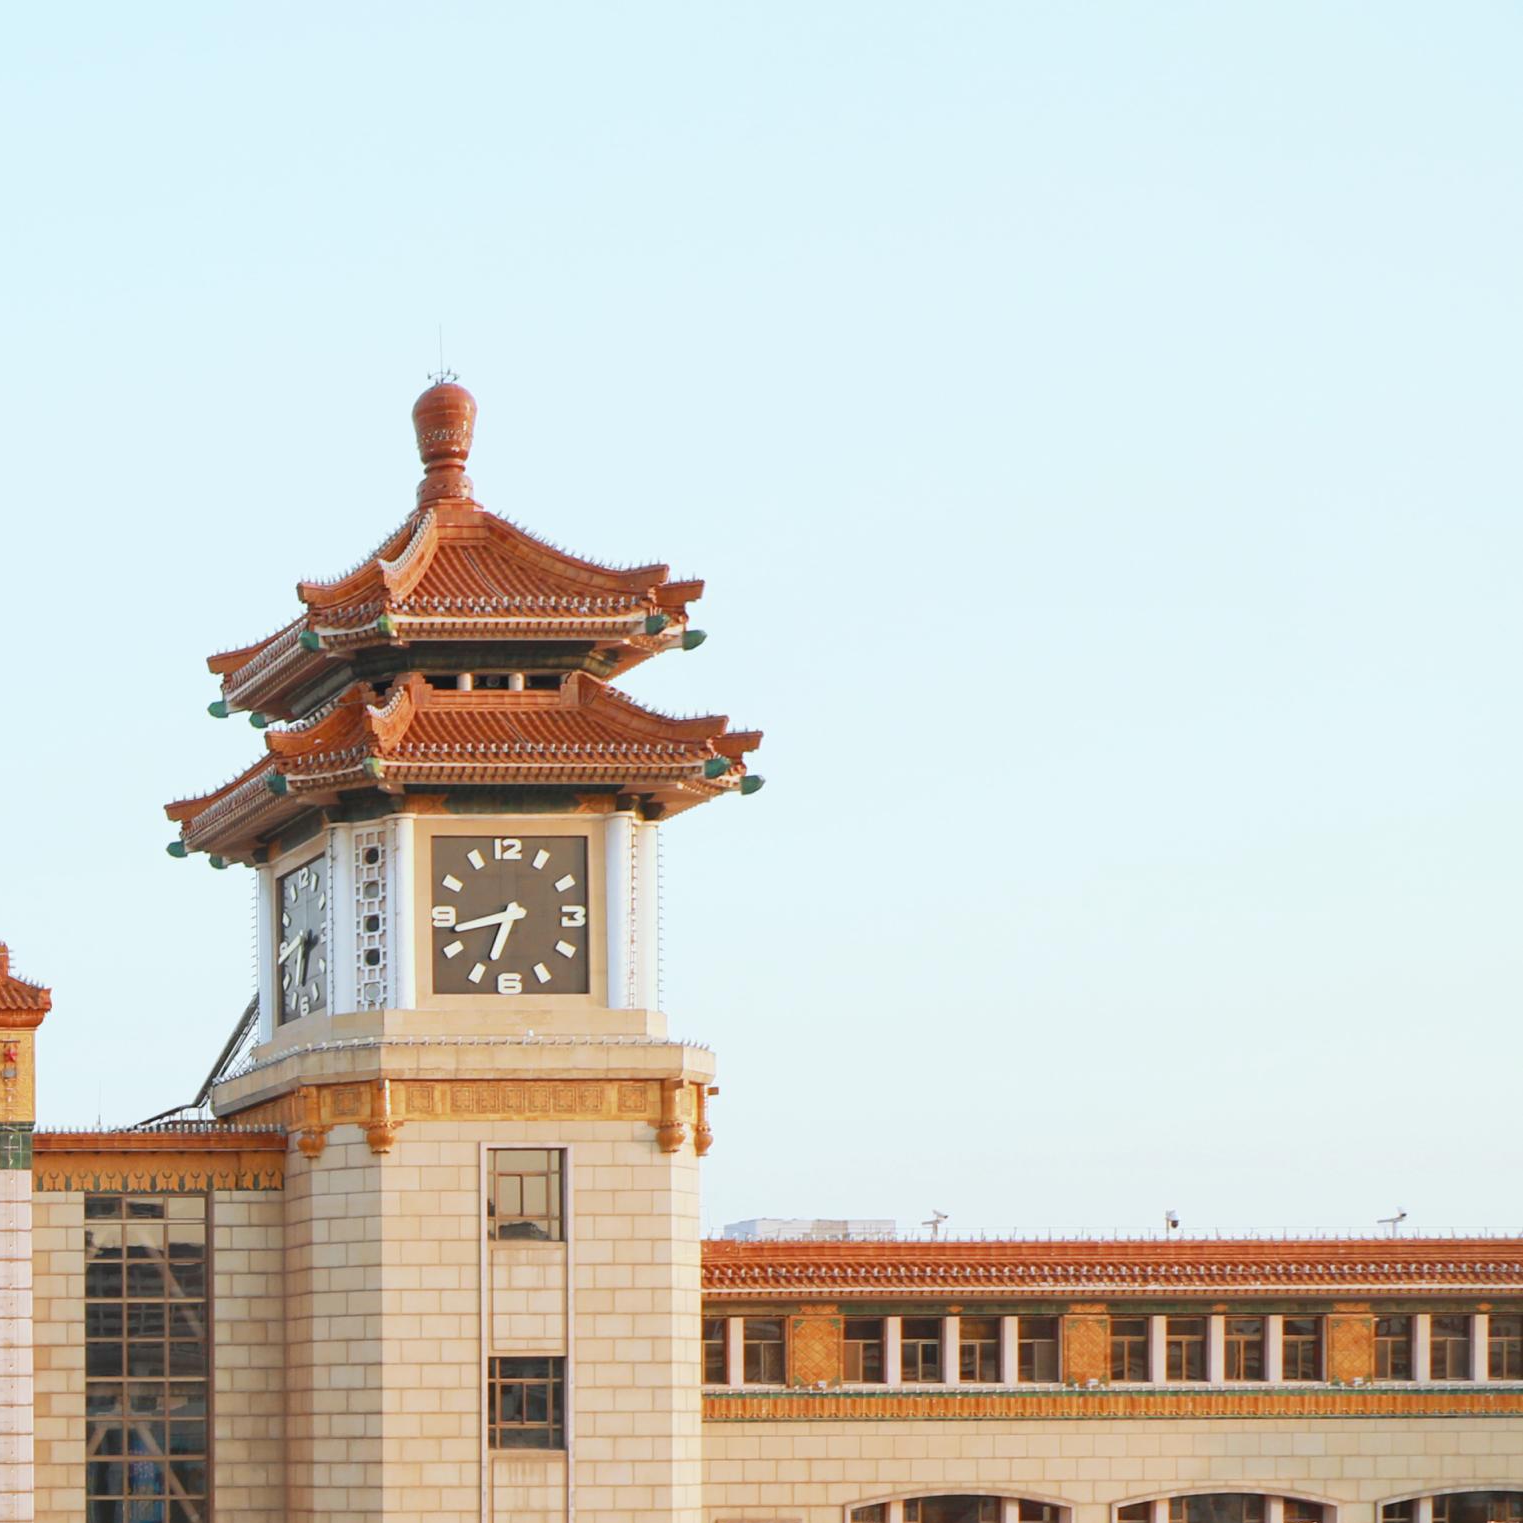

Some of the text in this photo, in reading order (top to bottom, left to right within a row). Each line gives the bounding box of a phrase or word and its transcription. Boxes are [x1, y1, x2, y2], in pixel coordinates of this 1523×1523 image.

[494, 839, 522, 860] 12
[298, 867, 310, 889] 12
[432, 906, 456, 927] 9
[561, 906, 585, 927] 3
[497, 973, 522, 994] 6
[300, 994, 310, 1017] 6
